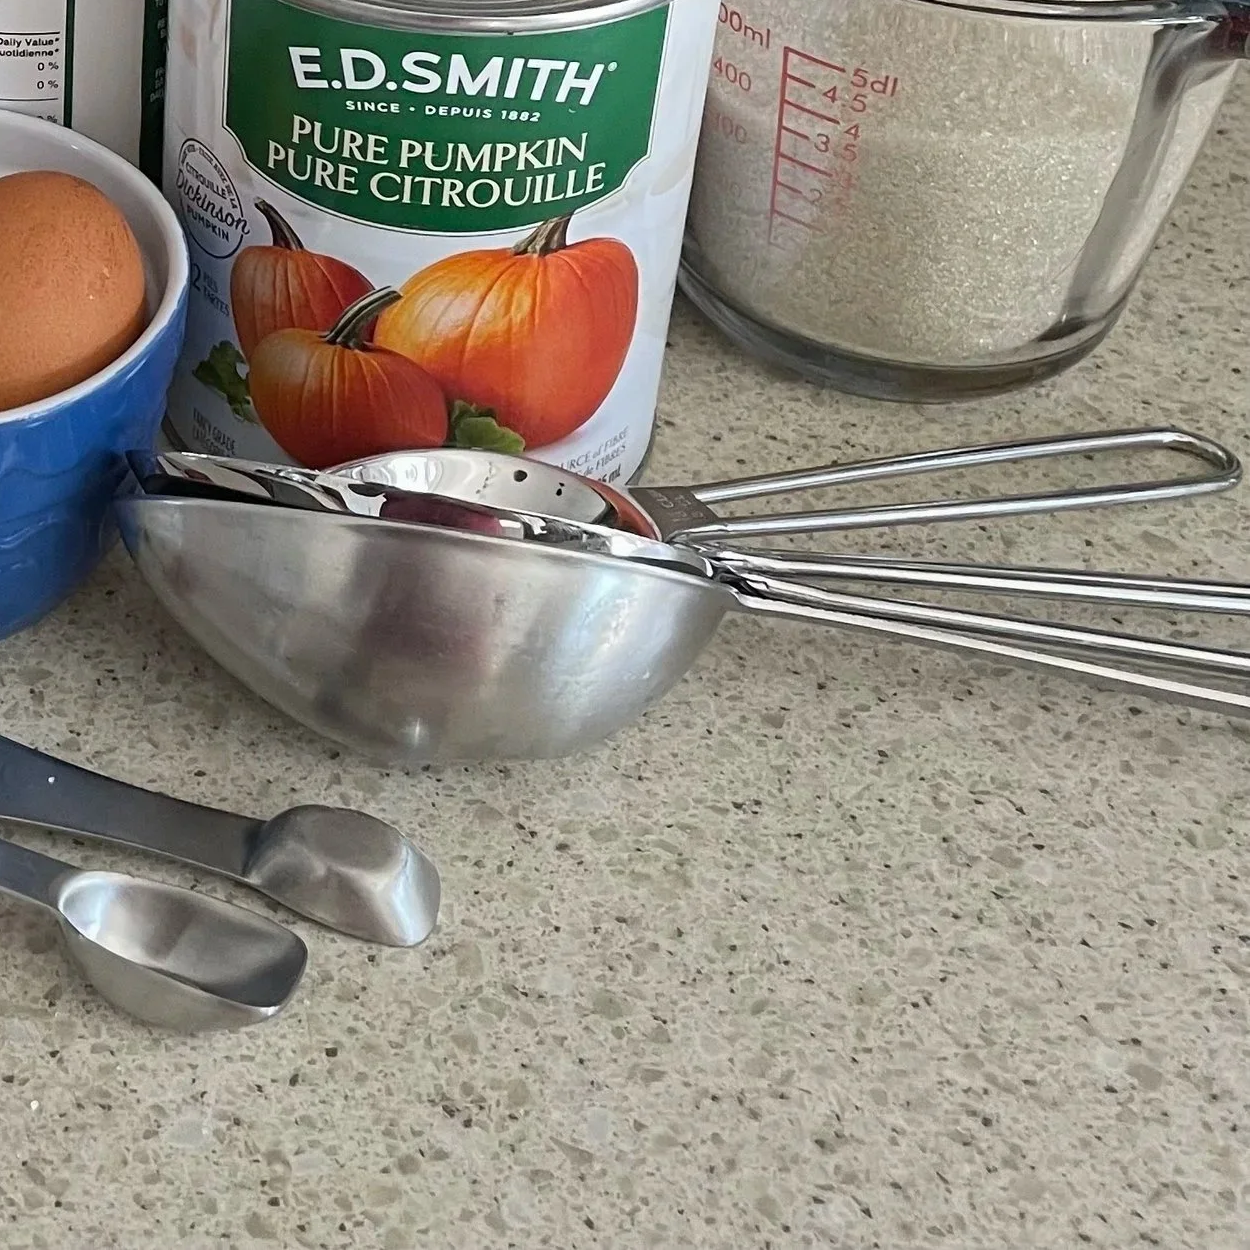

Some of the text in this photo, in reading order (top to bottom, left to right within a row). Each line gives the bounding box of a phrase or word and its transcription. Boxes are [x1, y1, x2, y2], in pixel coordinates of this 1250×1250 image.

[718, 1, 771, 49] 00ml
[37, 62, 59, 71] 0 %
[37, 80, 59, 89] 0 %
[713, 56, 899, 97] 400 5dl
[345, 100, 541, 123] SINCE DEPUIS 1882
[291, 114, 589, 174] PURE PUMPKIN
[844, 123, 861, 141] 4
[186, 161, 228, 200] CITROUILLE
[267, 139, 359, 195] PURE
[369, 161, 606, 208] CITROUILLE
[175, 168, 250, 236] Dickinson
[186, 205, 230, 243] PUMPKIN
